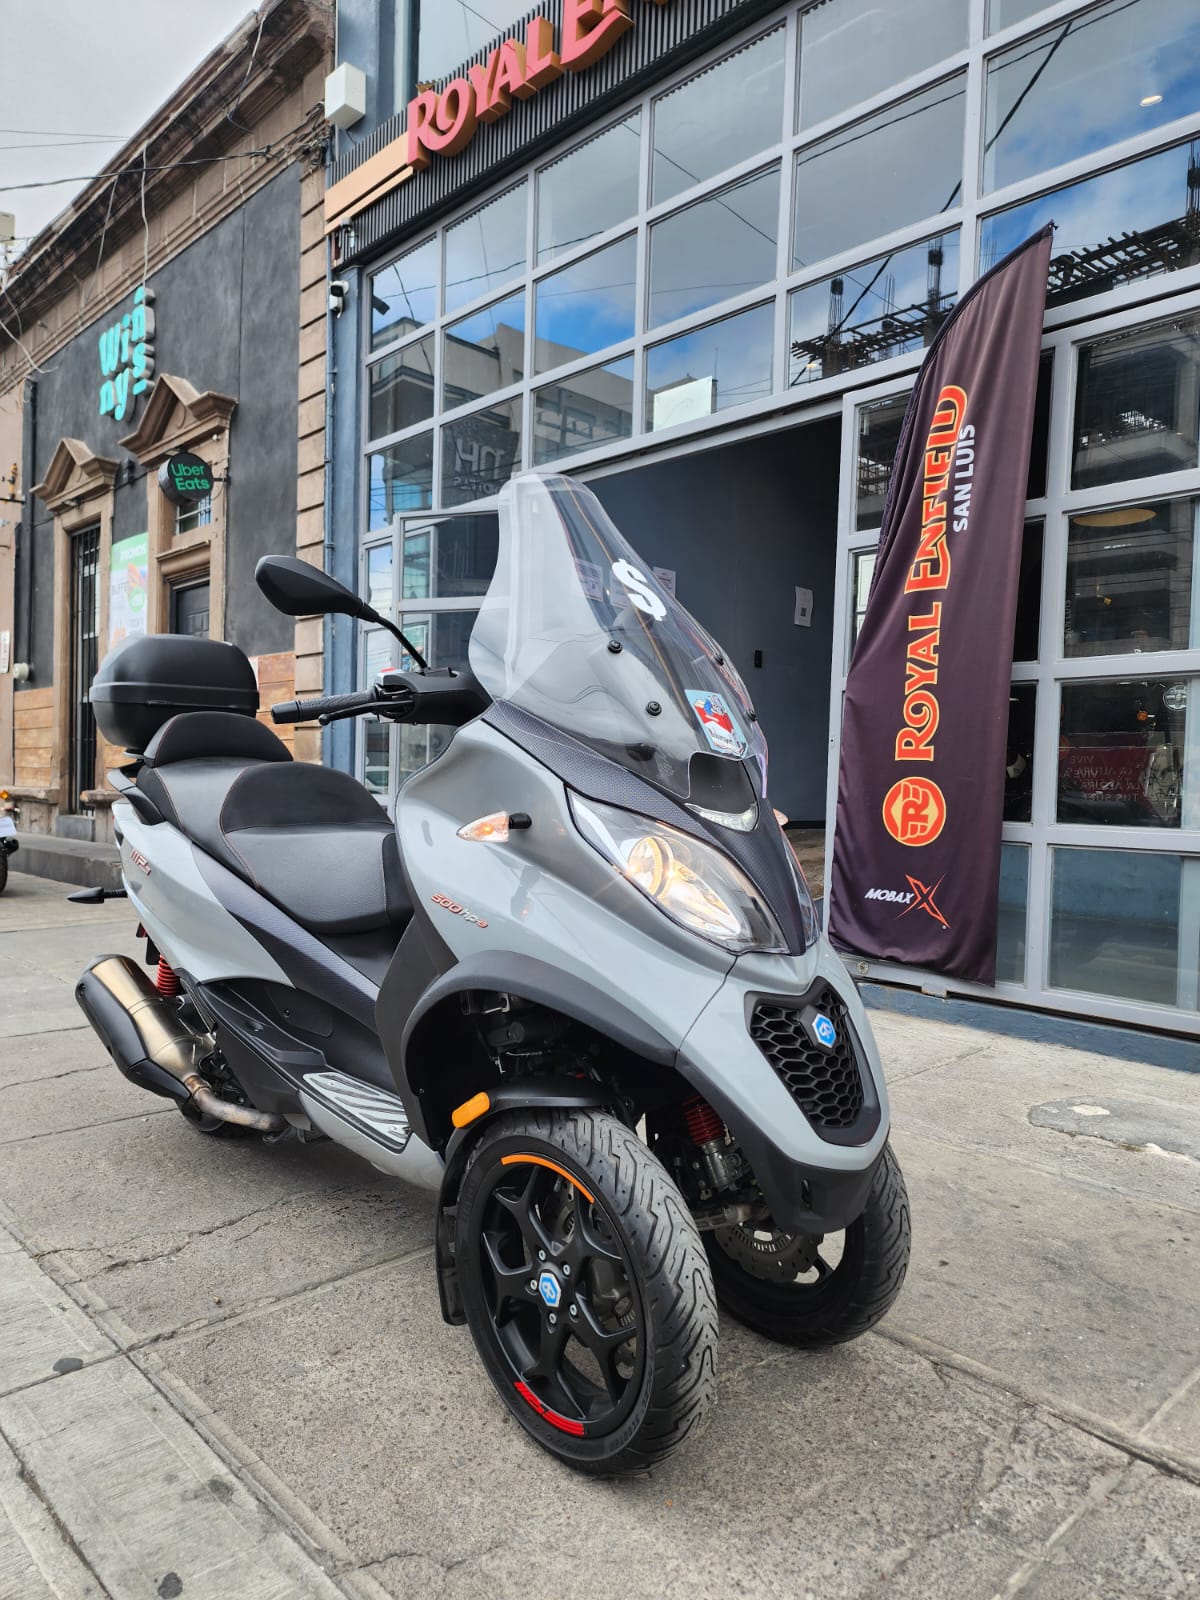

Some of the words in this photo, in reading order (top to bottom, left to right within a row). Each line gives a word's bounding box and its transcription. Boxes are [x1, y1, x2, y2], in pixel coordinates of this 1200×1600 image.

[406, 15, 560, 168] ROYAL
[170, 463, 205, 477] Uber
[955, 424, 976, 480] LUIS
[175, 477, 210, 490] Eats
[953, 485, 971, 533] SAN
[894, 601, 942, 762] ROYAL
[865, 888, 914, 904] MOBAX
